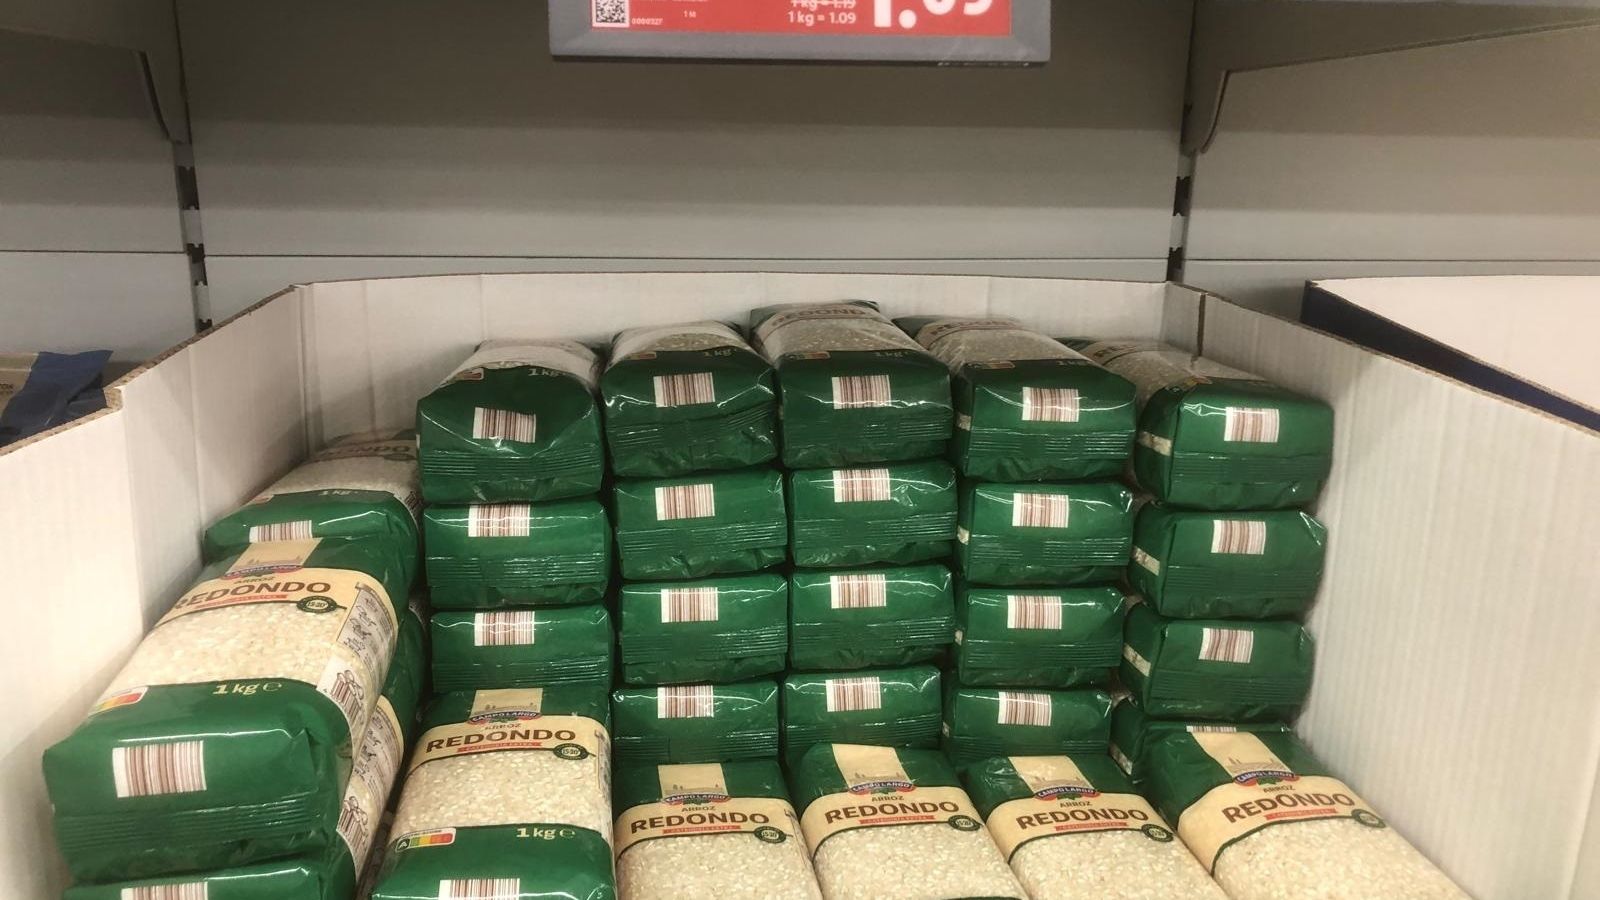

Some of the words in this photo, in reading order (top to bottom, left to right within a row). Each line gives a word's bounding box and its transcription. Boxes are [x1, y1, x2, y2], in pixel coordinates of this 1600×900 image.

[788, 12, 794, 23] 1
[797, 11, 814, 27] kg
[830, 12, 856, 24] 1.09
[213, 684, 228, 695] 1
[232, 683, 257, 695] kg
[426, 730, 576, 753] REDONDO
[825, 801, 959, 824] REDONDO
[1016, 808, 1149, 830] REDONDO
[1222, 793, 1355, 823] REDONDO
[516, 828, 530, 838] 1
[533, 828, 556, 840] kg
[631, 812, 769, 834] REDONDO
